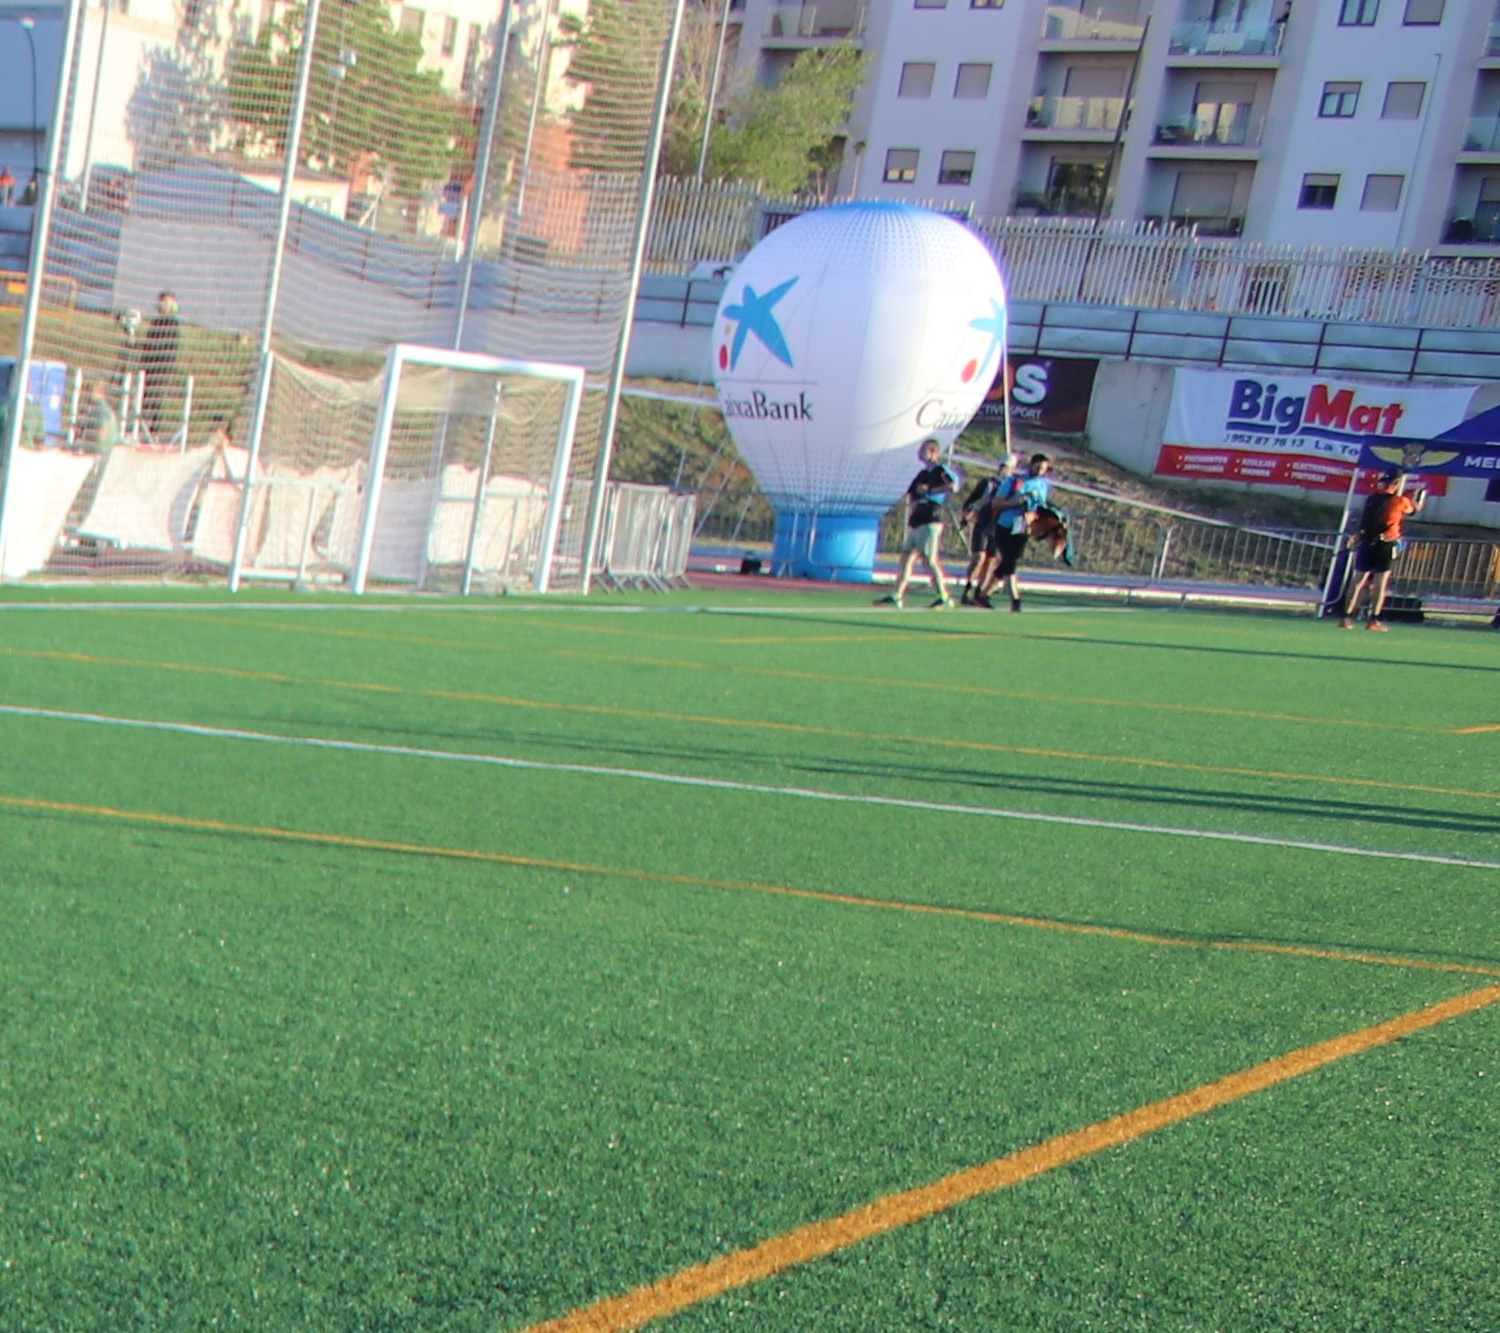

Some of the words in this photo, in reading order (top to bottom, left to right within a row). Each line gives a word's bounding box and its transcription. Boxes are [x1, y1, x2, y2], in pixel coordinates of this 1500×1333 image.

[1228, 379, 1404, 435] BigMat
[1231, 433, 1251, 445] 952
[1314, 440, 1333, 452] La
[1341, 444, 1360, 456] To
